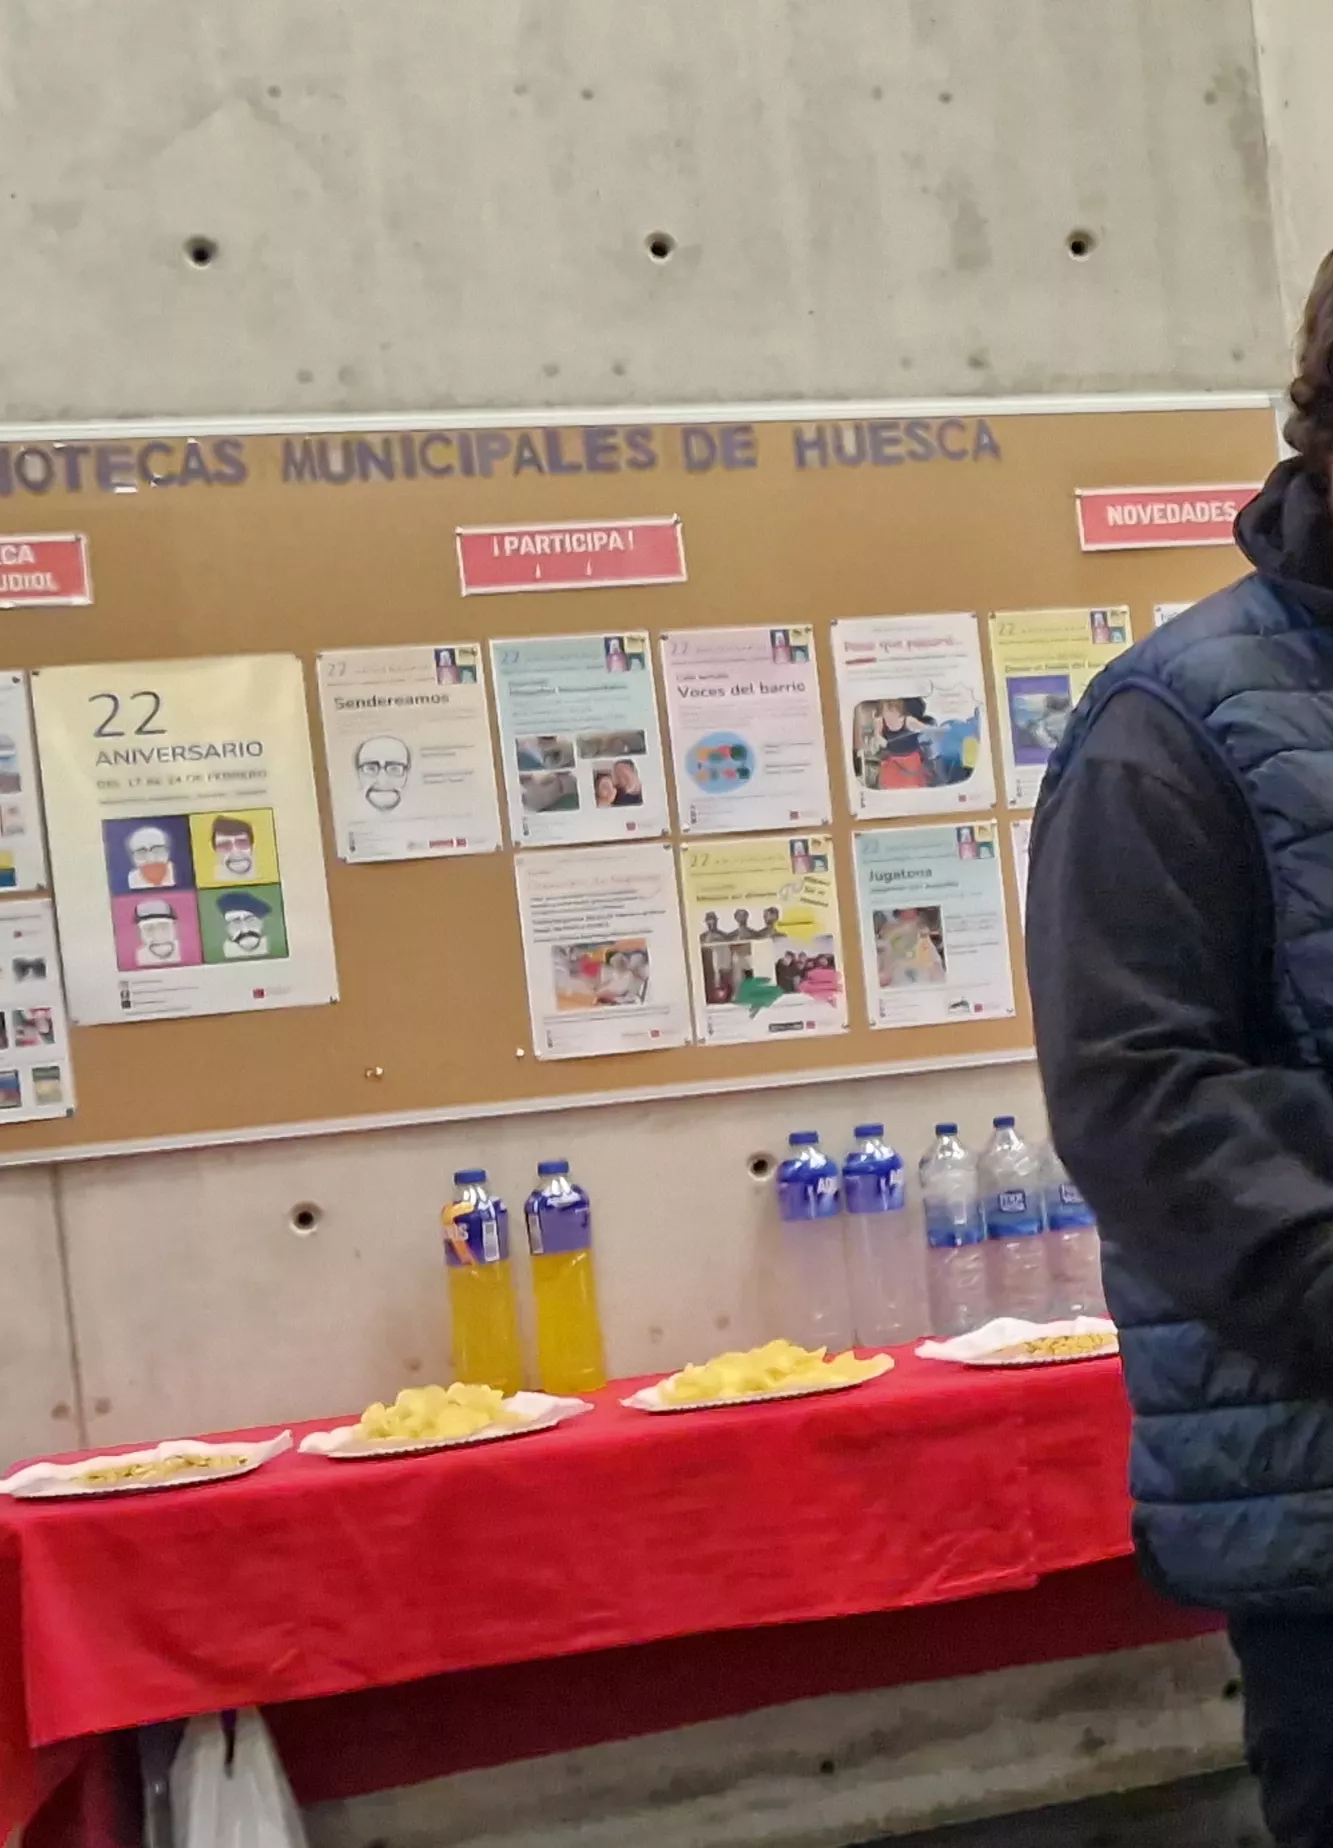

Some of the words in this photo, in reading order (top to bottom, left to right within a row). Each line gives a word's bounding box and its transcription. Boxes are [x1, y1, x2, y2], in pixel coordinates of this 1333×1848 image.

[281, 425, 657, 484] MUNICIPALES
[682, 424, 758, 473] DE
[795, 417, 1003, 470] HUESCA
[1106, 500, 1239, 527] NOVEDADES
[334, 693, 450, 711] Sendereamos
[676, 685, 726, 699] Voces
[730, 682, 754, 696] del
[759, 681, 806, 695] barrio
[88, 690, 168, 739] 22
[95, 740, 265, 767] ANIVERSARIO
